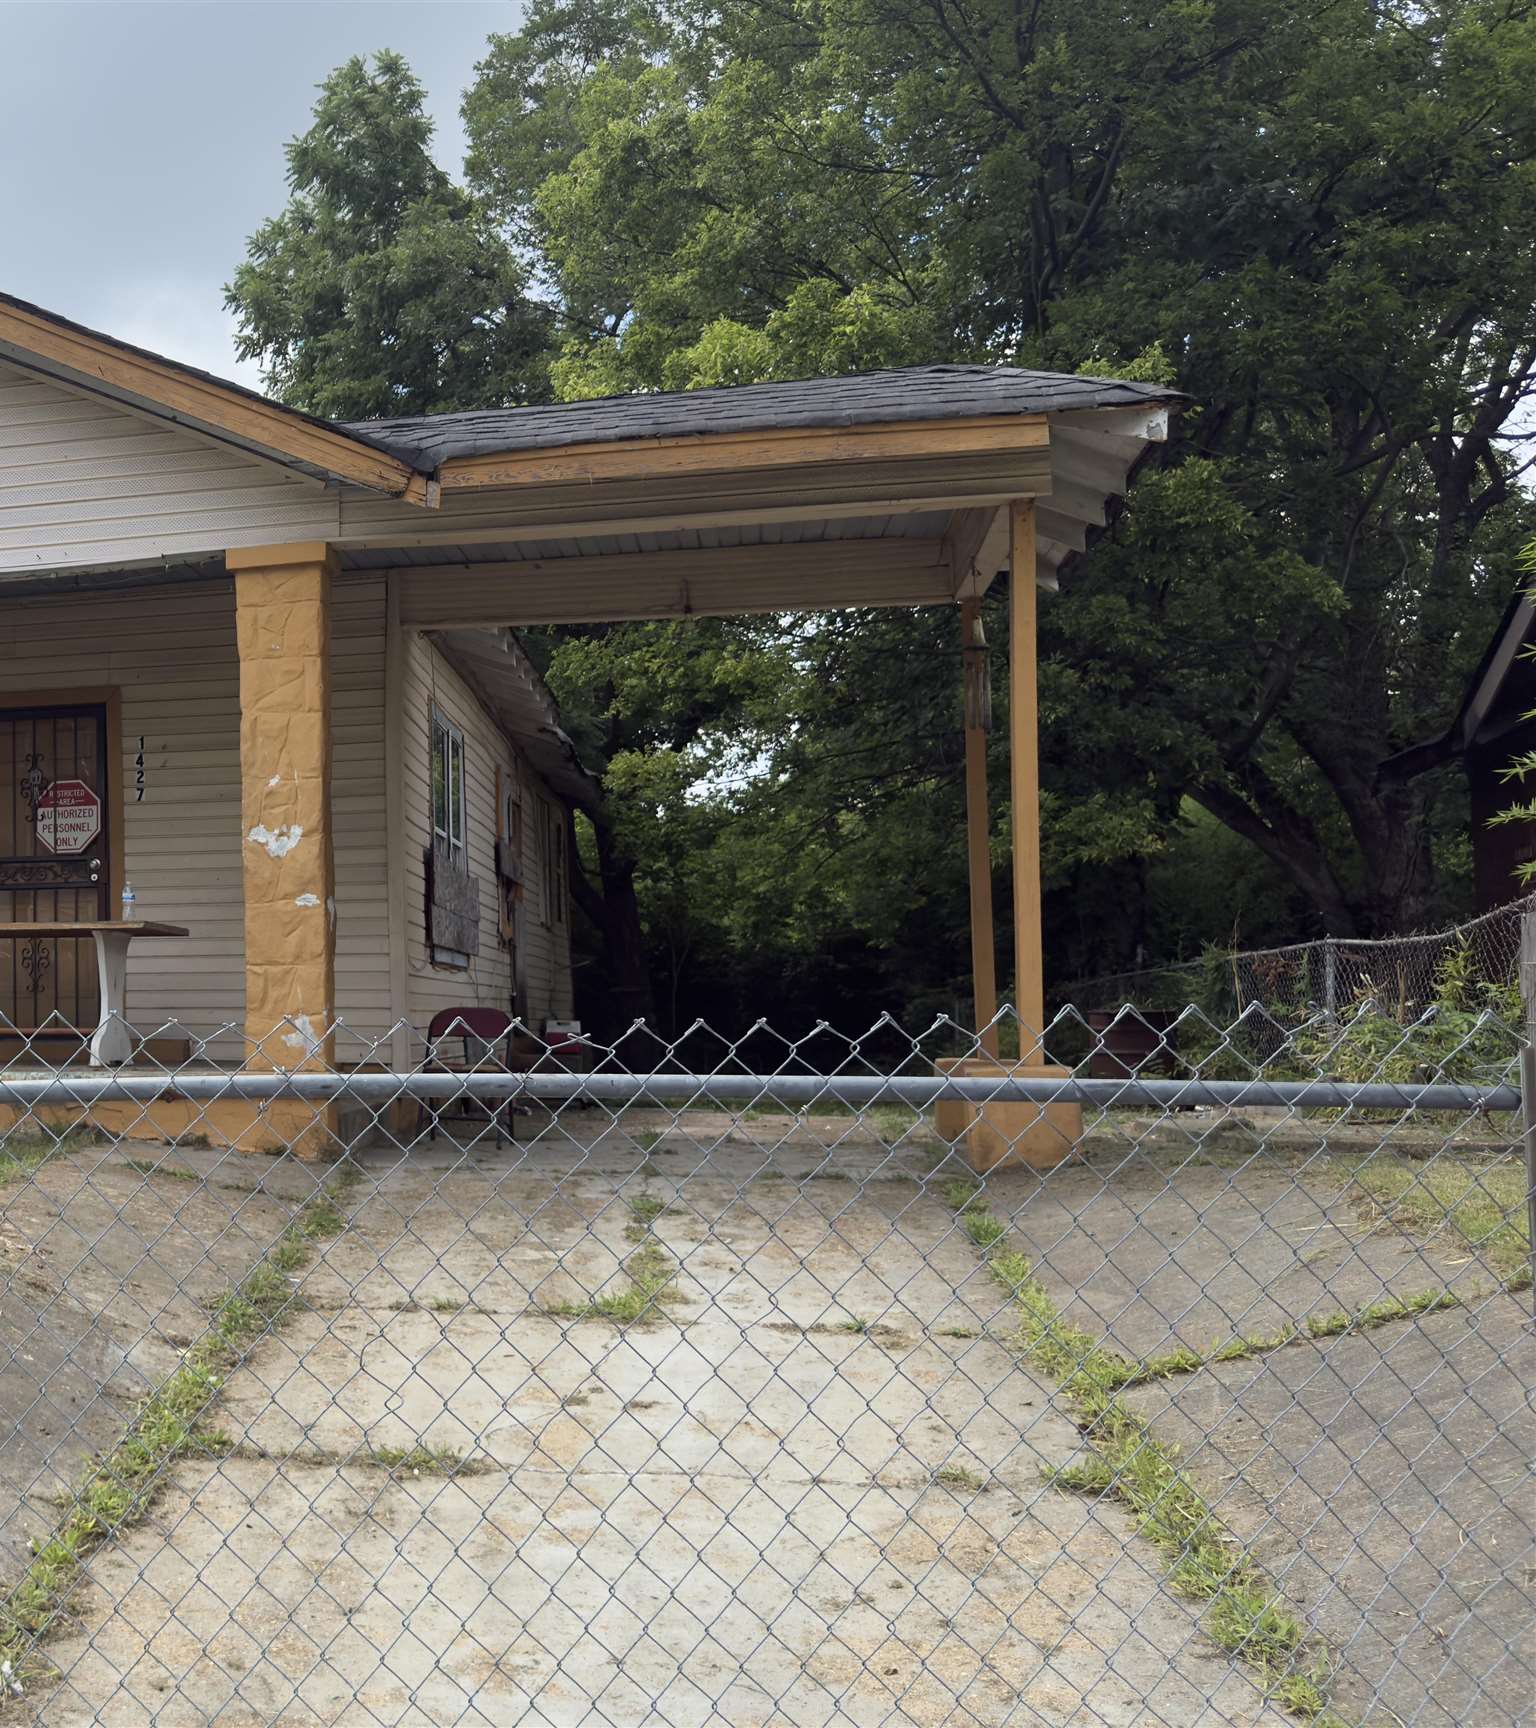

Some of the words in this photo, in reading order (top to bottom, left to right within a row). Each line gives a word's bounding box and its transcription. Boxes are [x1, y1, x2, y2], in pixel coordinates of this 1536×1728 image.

[135, 735, 144, 801] 1427
[49, 789, 85, 798] RSTRICTED
[41, 808, 94, 819] AUHORIZED
[56, 837, 78, 847] ONLY
